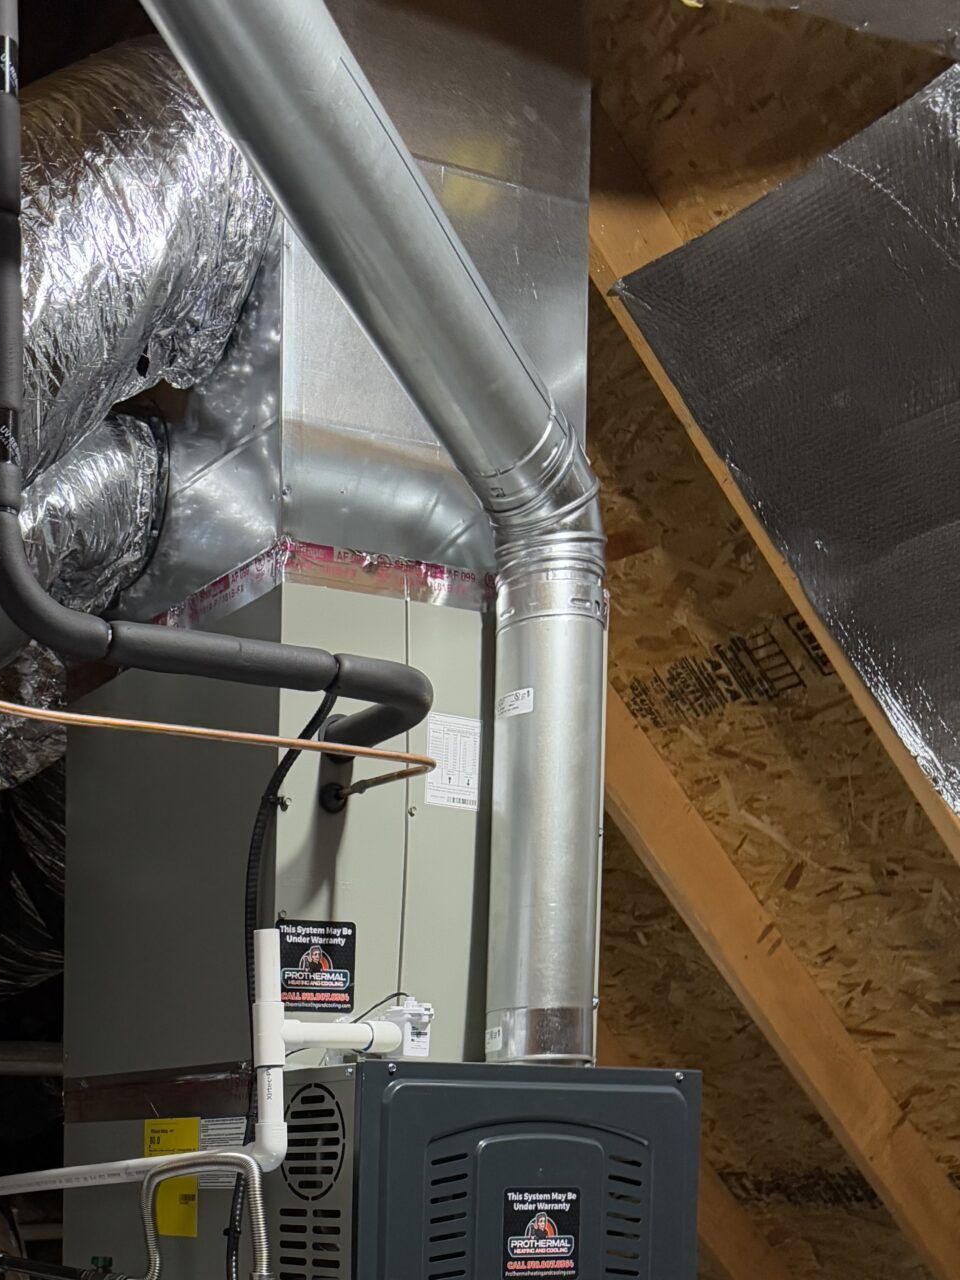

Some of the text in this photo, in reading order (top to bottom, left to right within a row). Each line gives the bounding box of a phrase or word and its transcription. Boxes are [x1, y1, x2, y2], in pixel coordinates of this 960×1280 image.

[461, 572, 476, 583] 099
[705, 653, 743, 702] APA
[280, 925, 352, 937] This System May Be
[286, 936, 346, 946] Under Warranty
[285, 971, 346, 981] PROTHERMAL
[281, 992, 301, 1000] CALL
[507, 1192, 577, 1202] This System May Be
[513, 1202, 571, 1212] Under Warranty
[511, 1239, 571, 1248] PROTHERMAL
[507, 1261, 526, 1270] CALL
